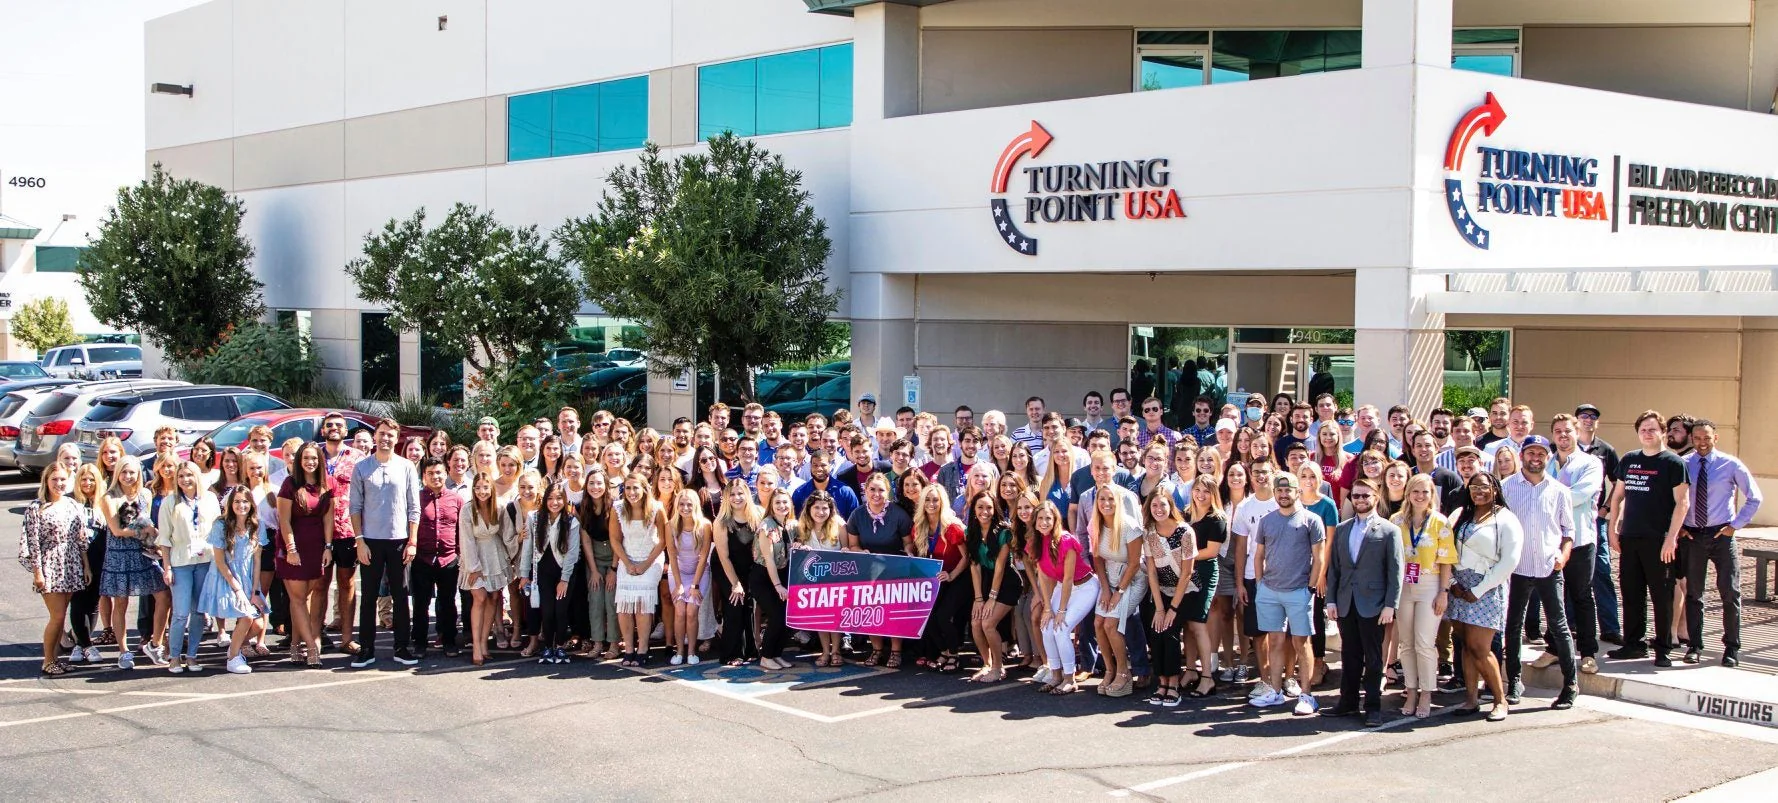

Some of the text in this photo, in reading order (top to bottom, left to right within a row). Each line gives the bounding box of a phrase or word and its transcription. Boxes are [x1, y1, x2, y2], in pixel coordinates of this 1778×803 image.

[8, 176, 46, 189] 4960
[1023, 158, 1170, 194] TURNING
[1477, 146, 1598, 187] TURNING
[1628, 163, 1663, 190] BILL
[1661, 167, 1698, 193] AND
[1697, 171, 1765, 200] REBECCA
[1024, 188, 1187, 224] POINT USA
[1477, 181, 1609, 221] POINT USA
[1628, 195, 1728, 231] FREEDOM
[812, 560, 858, 577] TPUSA
[797, 581, 932, 609] STAFF TRAINING
[840, 606, 885, 628] 2020
[1697, 695, 1773, 722] VISITORS
